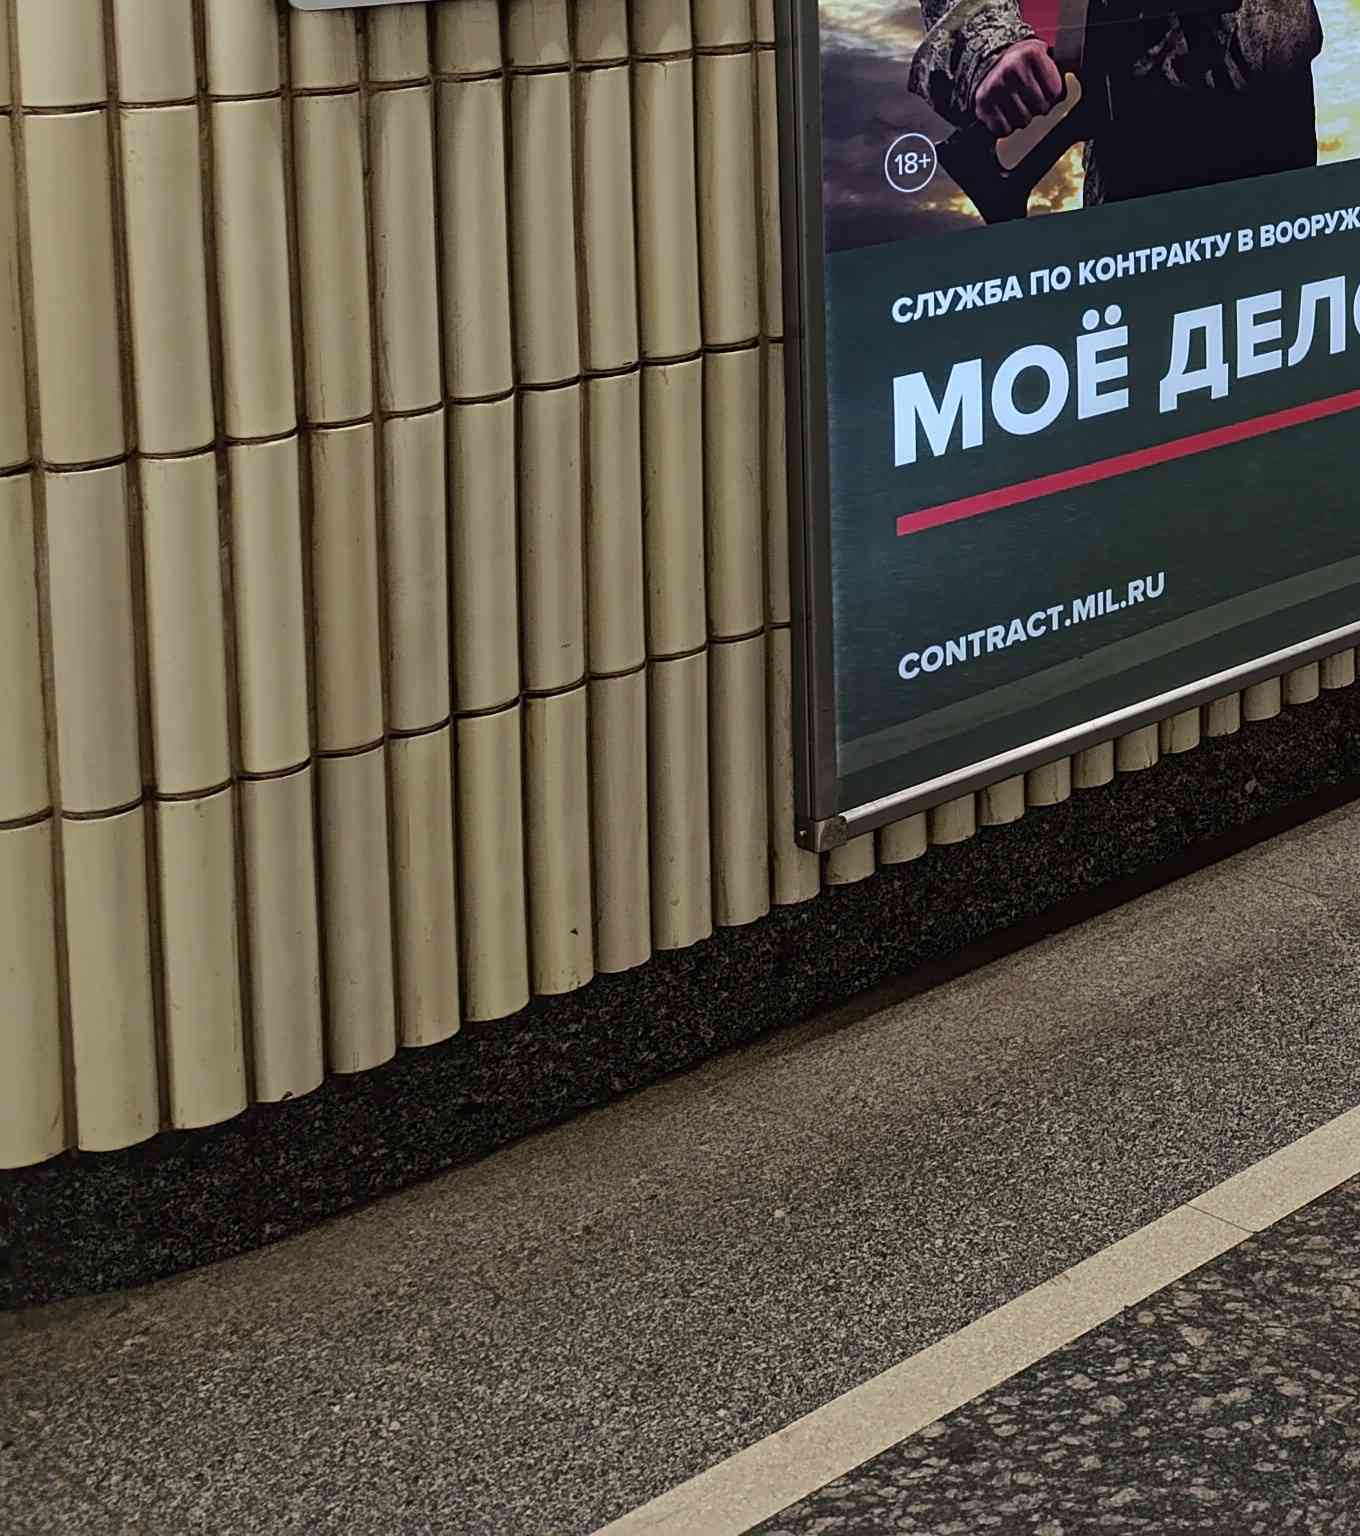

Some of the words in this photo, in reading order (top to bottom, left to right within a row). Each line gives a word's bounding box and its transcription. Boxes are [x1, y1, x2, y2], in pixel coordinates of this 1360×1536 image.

[894, 152, 931, 176] 18+
[891, 275, 1024, 324] СЛУЖБА
[1030, 265, 1072, 296] ПО
[1078, 232, 1232, 285] КОНТРАКТУ
[1237, 228, 1255, 253] В
[892, 303, 1130, 467] МОЁ
[898, 571, 1165, 680] CONTRACT.MIL.RU
